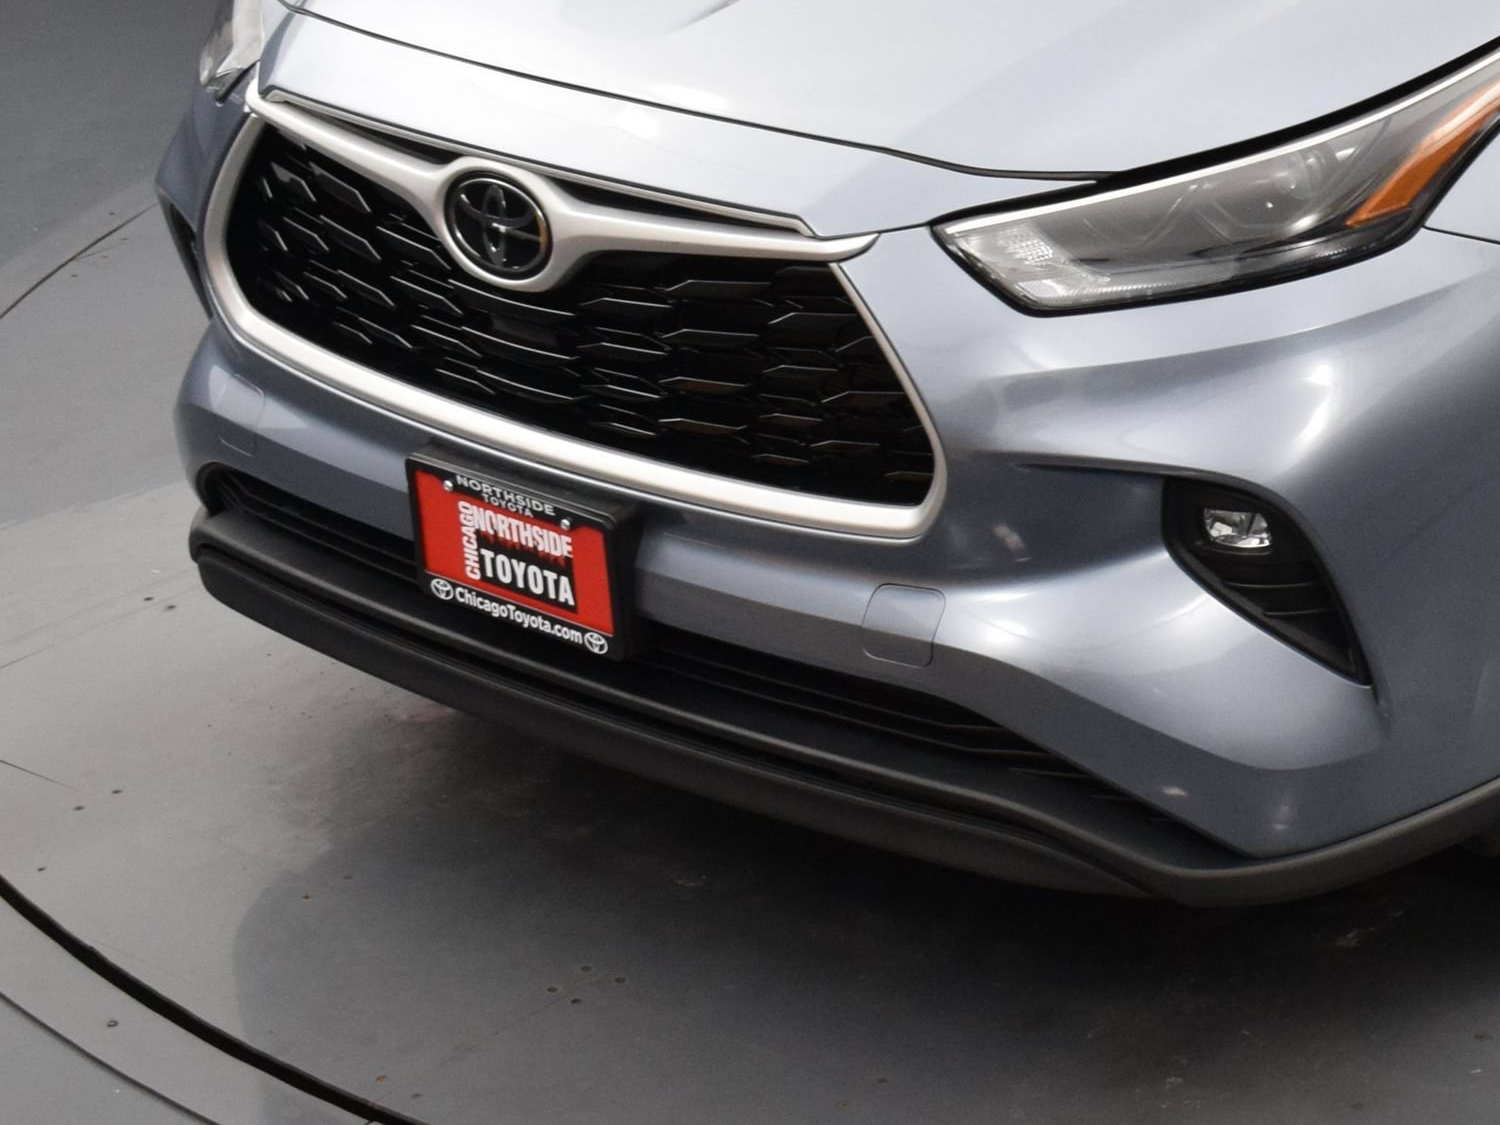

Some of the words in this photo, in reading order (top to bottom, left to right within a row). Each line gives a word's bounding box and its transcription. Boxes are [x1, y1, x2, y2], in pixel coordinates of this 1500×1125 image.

[456, 475, 554, 516] NORTHSIDE
[482, 494, 533, 518] TOYOTA
[458, 500, 481, 581] CHICAGO
[473, 507, 574, 558] NORTHSIDE
[480, 548, 575, 606] TOYOTA
[456, 587, 583, 645] ChicagoToyota.com
